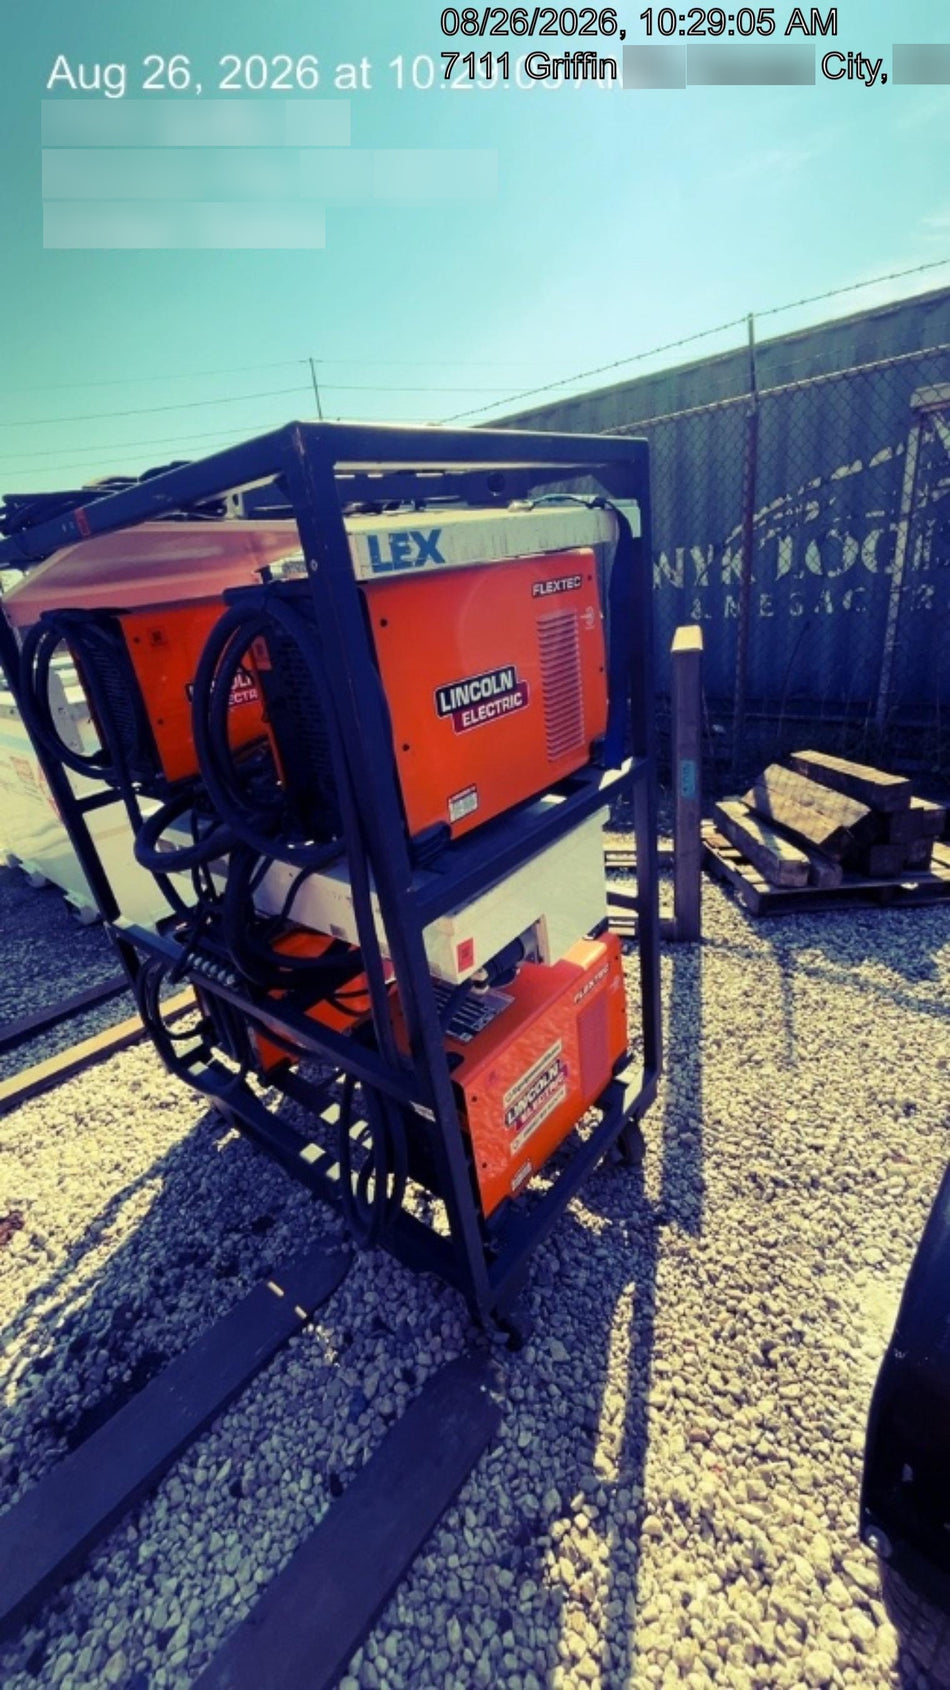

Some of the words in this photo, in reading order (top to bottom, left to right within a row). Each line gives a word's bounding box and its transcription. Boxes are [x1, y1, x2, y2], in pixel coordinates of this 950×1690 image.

[368, 529, 445, 574] LEX
[533, 577, 581, 596] FLEXTEC
[440, 670, 513, 712] LINCOLN
[462, 692, 522, 727] ELECTRIC
